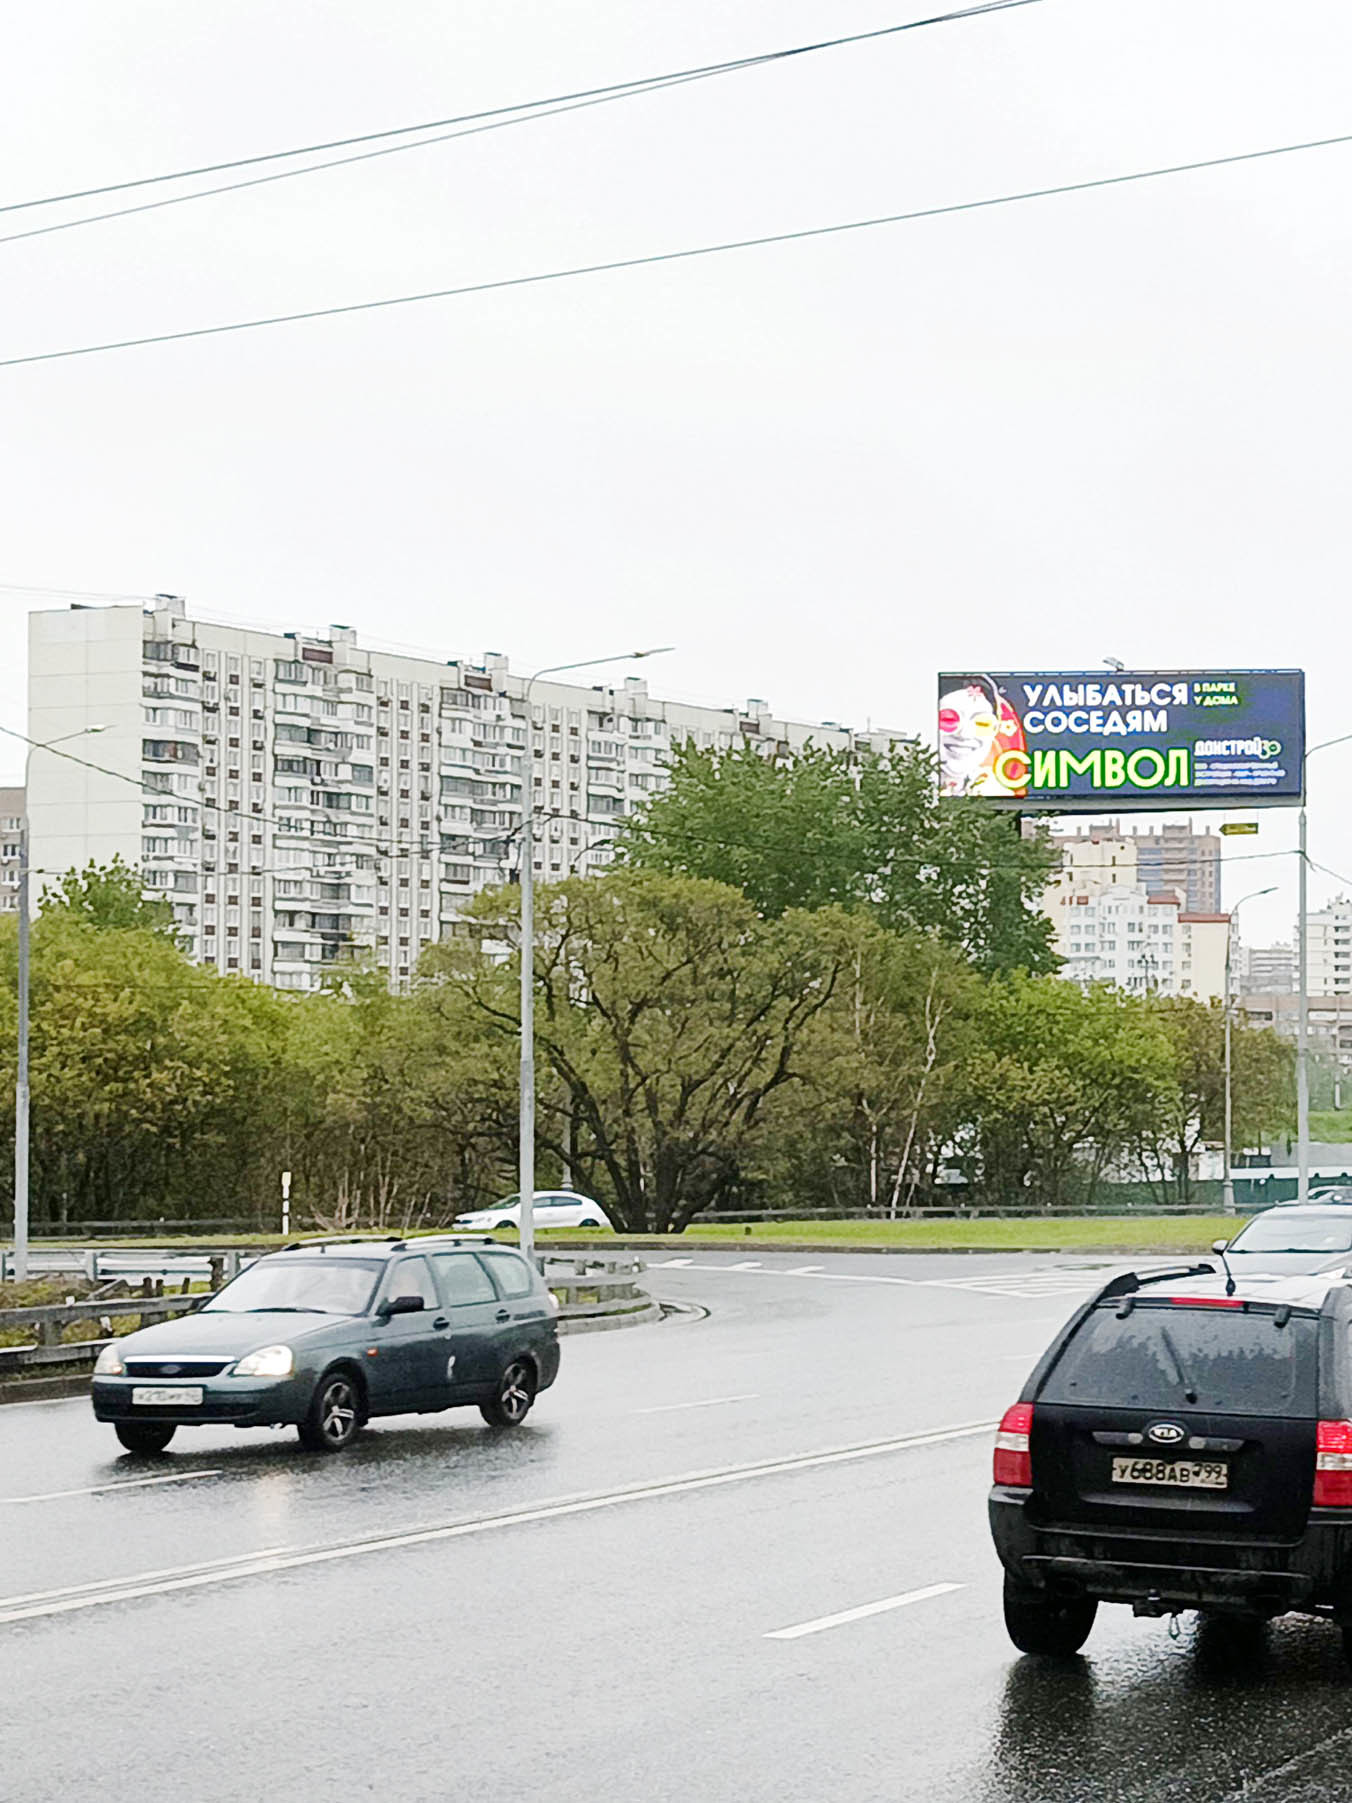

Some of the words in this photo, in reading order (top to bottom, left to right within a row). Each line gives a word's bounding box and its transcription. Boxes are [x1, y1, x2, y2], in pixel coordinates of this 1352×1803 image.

[1023, 683, 1188, 706] УЛЫБАТЬСЯ
[1023, 710, 1168, 736] СОСЕДЯМ
[995, 749, 1189, 788] СИМВОЛ
